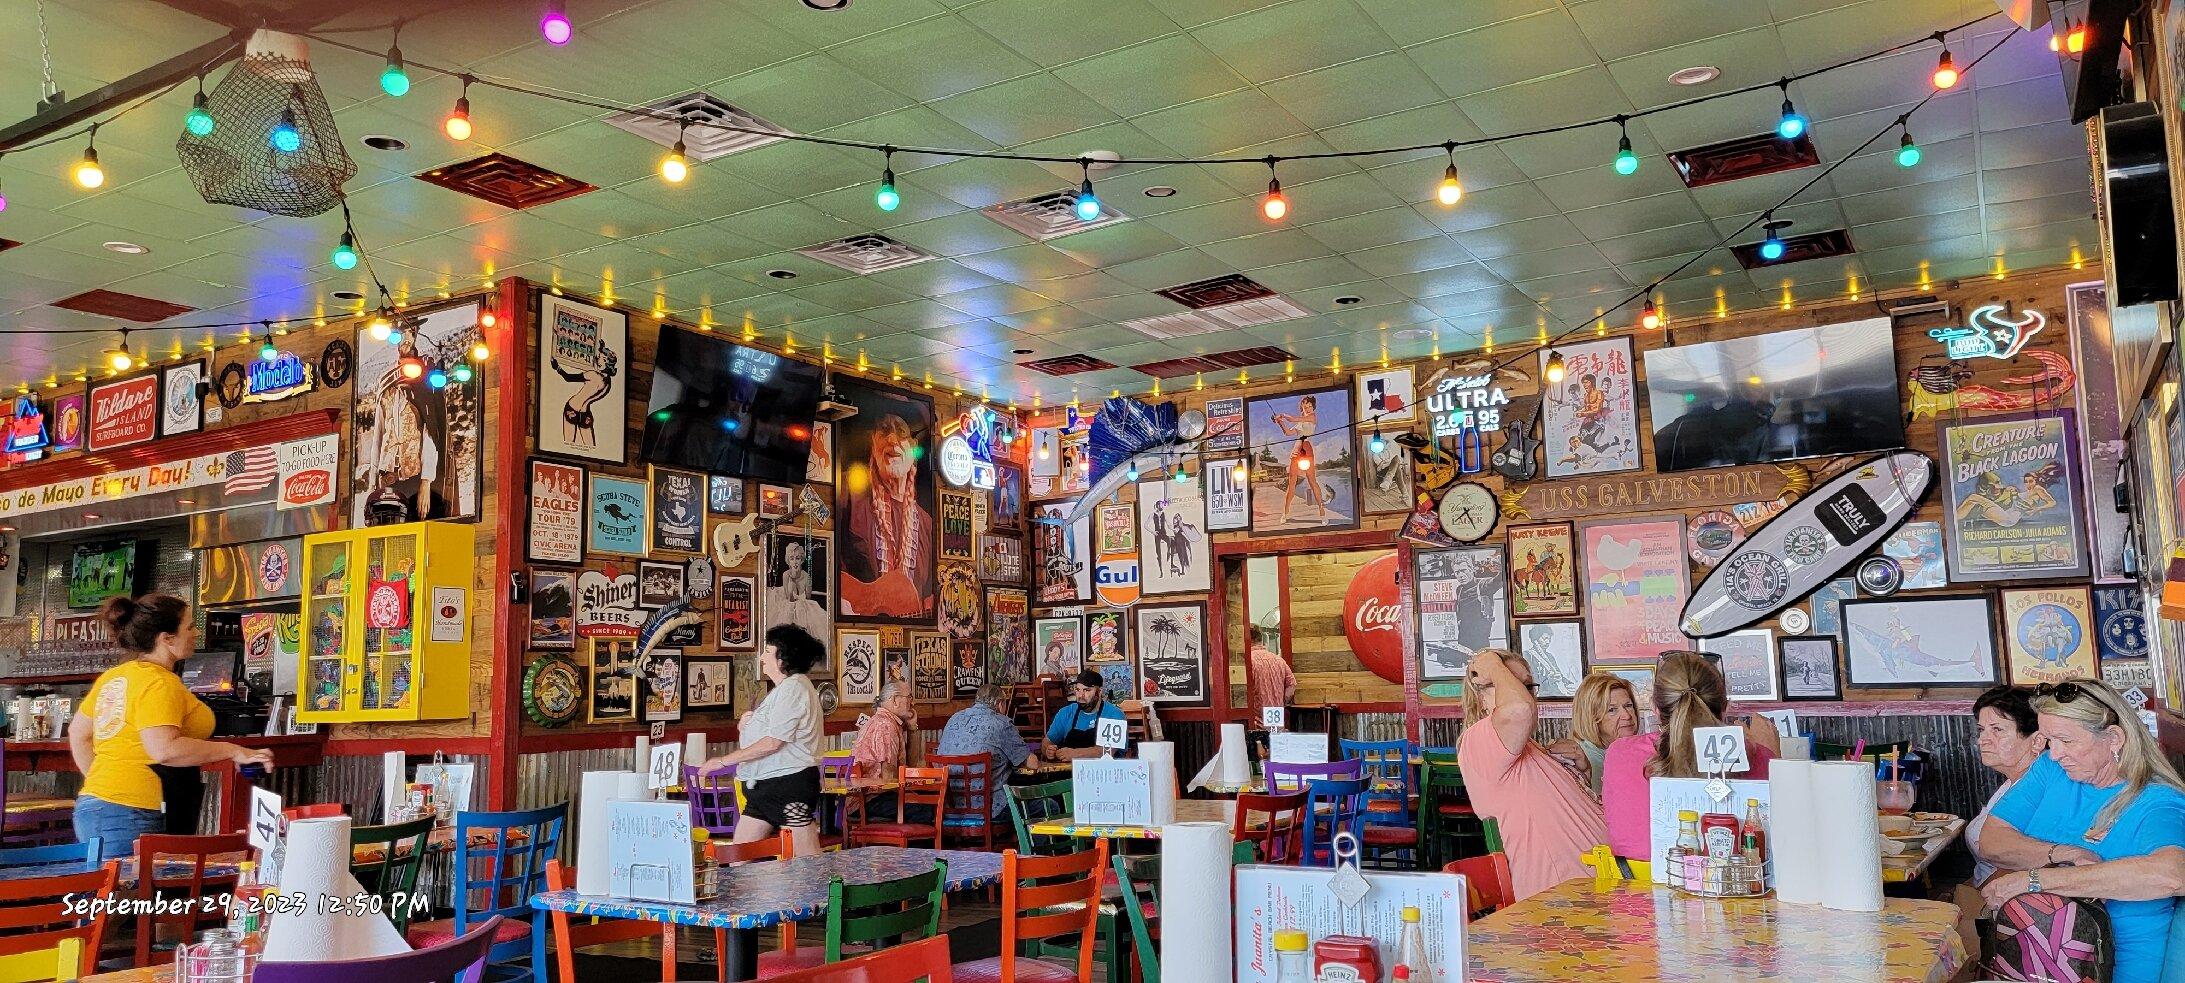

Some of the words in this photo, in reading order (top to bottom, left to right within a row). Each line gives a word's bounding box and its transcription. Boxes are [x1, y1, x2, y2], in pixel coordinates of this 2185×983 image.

[251, 357, 303, 393] Modelo
[1427, 387, 1510, 413] ULTRA
[115, 403, 153, 426] ISLAND
[1478, 409, 1501, 425] 95
[96, 426, 134, 442] SURFBOARD
[1972, 423, 2047, 453] CREATURE
[292, 440, 327, 457] PICK-UP
[1957, 457, 2000, 483] BLACK
[2002, 442, 2059, 468] LAGOON
[18, 490, 36, 508] de
[42, 484, 84, 504] Mayo
[148, 460, 192, 487] Day!
[1539, 485, 1588, 513] USS
[1597, 469, 1763, 507] GALVESTON
[533, 496, 579, 513] EAGLES
[1227, 492, 1244, 508] WSM
[537, 513, 561, 524] TOUR
[943, 503, 970, 521] PEACE
[1839, 494, 1871, 529] TRULY
[944, 519, 970, 536] LOVE
[553, 542, 577, 550] ARENA
[1733, 552, 1771, 567] OCEAN
[1725, 566, 1736, 592] TIA'S
[1770, 560, 1787, 587] GRILL
[581, 581, 637, 612] Shiner
[1433, 582, 1453, 592] STEVE
[2037, 592, 2085, 611] POLLOS
[589, 611, 630, 624] BEERS
[56, 619, 108, 642] PLEASU
[592, 627, 611, 635] SINCE
[843, 638, 876, 659] RESPECT
[915, 636, 947, 656] TEXAS
[953, 665, 984, 679] CRAWFISH
[1730, 680, 1767, 693] PRETTY
[2125, 690, 2144, 705] 33
[1266, 709, 1282, 724] 38
[652, 724, 663, 737] 23
[1101, 723, 1122, 744] 49
[1703, 734, 1741, 764] 42
[653, 750, 675, 780] 48
[255, 797, 278, 844] 47
[1250, 905, 1267, 977] Juanita's
[1327, 970, 1353, 982] HEINZ
